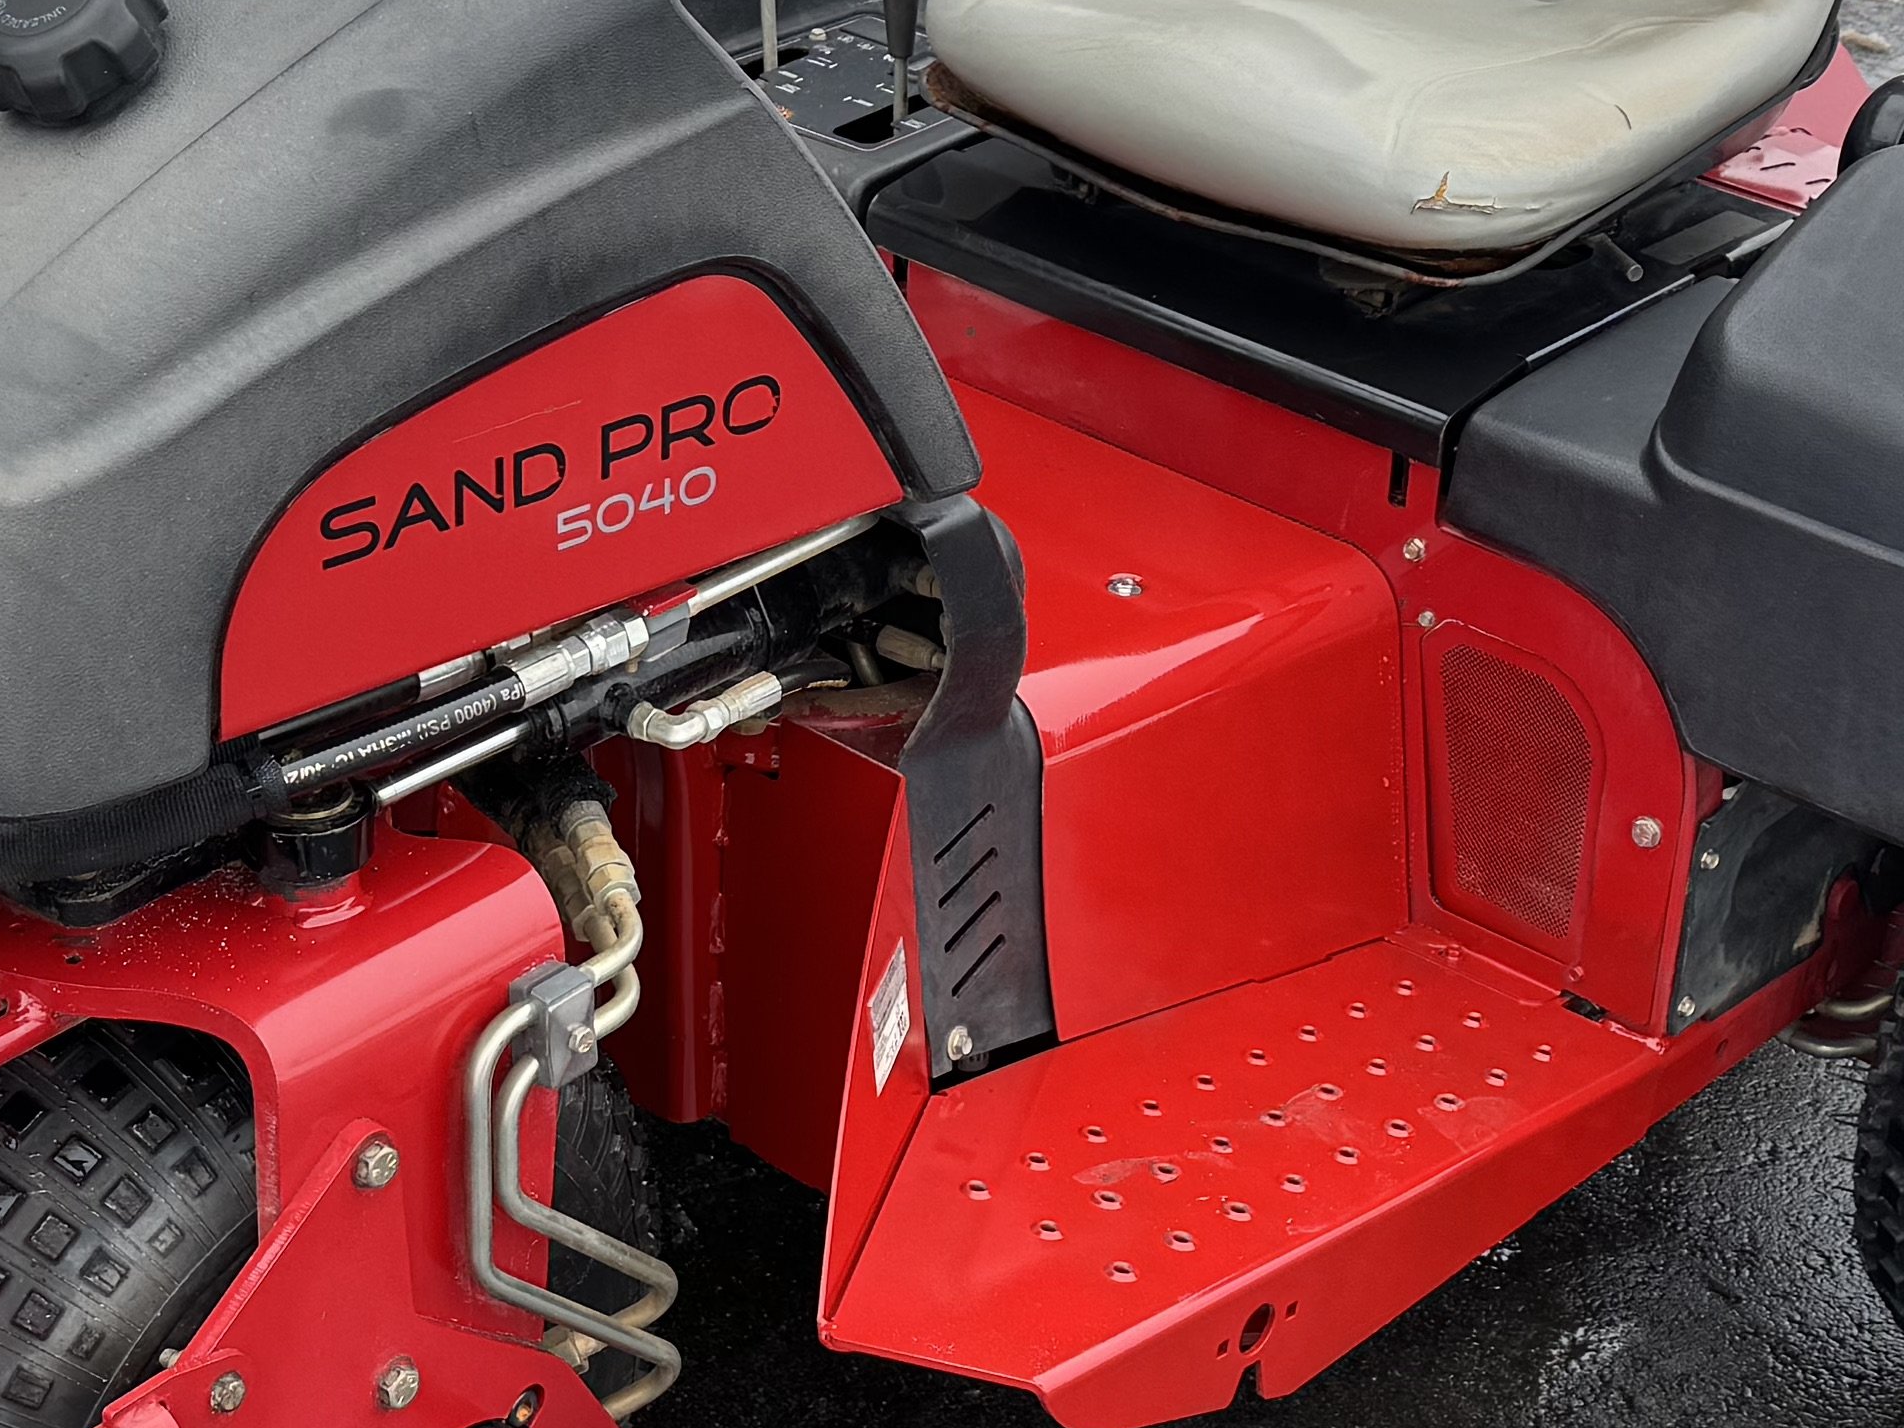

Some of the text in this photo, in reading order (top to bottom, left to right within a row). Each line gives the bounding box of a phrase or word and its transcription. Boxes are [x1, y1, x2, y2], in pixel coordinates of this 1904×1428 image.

[0, 5, 67, 29] UNLEADED
[320, 371, 784, 571] SAND PRO
[554, 466, 720, 553] 5040
[454, 693, 497, 724] (4000
